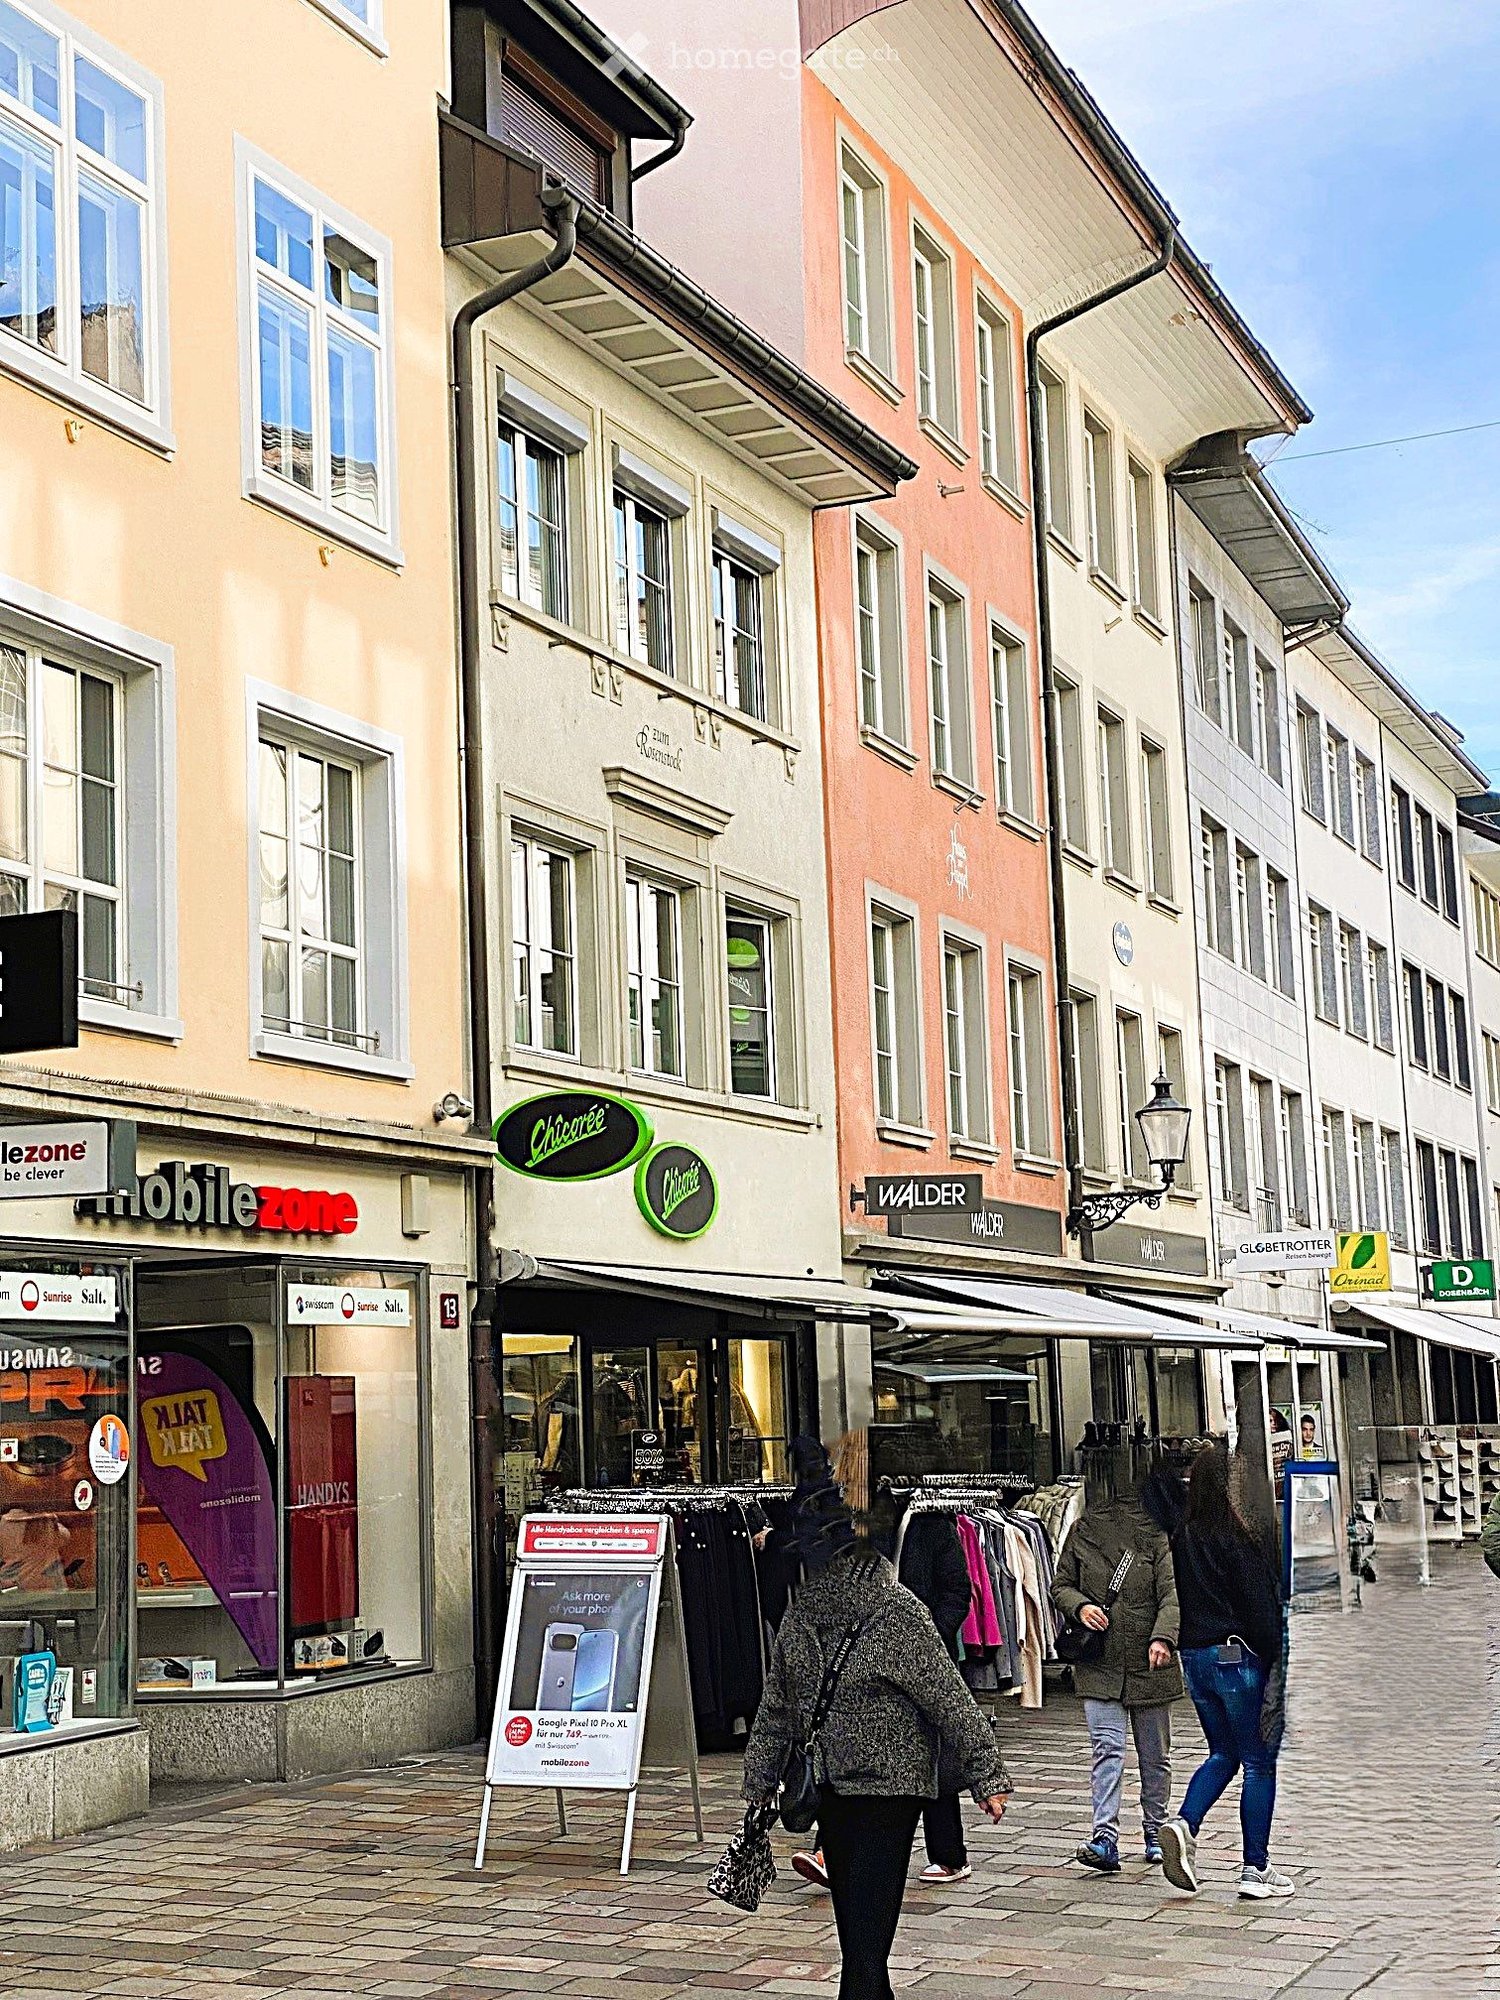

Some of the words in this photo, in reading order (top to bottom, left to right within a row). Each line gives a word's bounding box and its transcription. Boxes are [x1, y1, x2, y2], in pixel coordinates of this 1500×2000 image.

[652, 727, 670, 746] zum
[636, 724, 684, 772] Rosenstock
[4, 1168, 21, 1181] be
[26, 1166, 65, 1180] clever
[878, 1178, 966, 1209] WALDER
[970, 1205, 1004, 1239] WALDER
[1139, 1234, 1166, 1262] WALDER
[1239, 1239, 1333, 1254] GLOBETROTTER
[1308, 1252, 1332, 1260] bewegt
[1452, 1265, 1474, 1287] D
[43, 1290, 73, 1303] Sunrise
[81, 1288, 107, 1304] Salt.
[1439, 1287, 1490, 1298] DOSENBACH
[304, 1298, 335, 1310] swisscom
[357, 1301, 379, 1312] Sunrise
[384, 1299, 404, 1313] Salt.
[443, 1297, 457, 1319] 13
[635, 1448, 665, 1465] 50%
[297, 1481, 350, 1505] HANDYS
[530, 1525, 545, 1533] Alle
[545, 1525, 583, 1535] Handyabos
[584, 1526, 623, 1535] vergleichen
[624, 1526, 630, 1534] &
[631, 1527, 655, 1536] sparen
[562, 1591, 583, 1601] Ask
[583, 1591, 611, 1601] more
[548, 1603, 562, 1615] of
[562, 1604, 587, 1616] your
[587, 1603, 619, 1617] phone
[537, 1717, 568, 1729] Google
[569, 1718, 589, 1728] Pixel
[590, 1719, 598, 1728] 10
[600, 1719, 615, 1729] Pro
[616, 1719, 628, 1729] XL
[536, 1728, 548, 1738] für
[534, 1741, 546, 1749] mit
[540, 1758, 590, 1767] mobilezone
